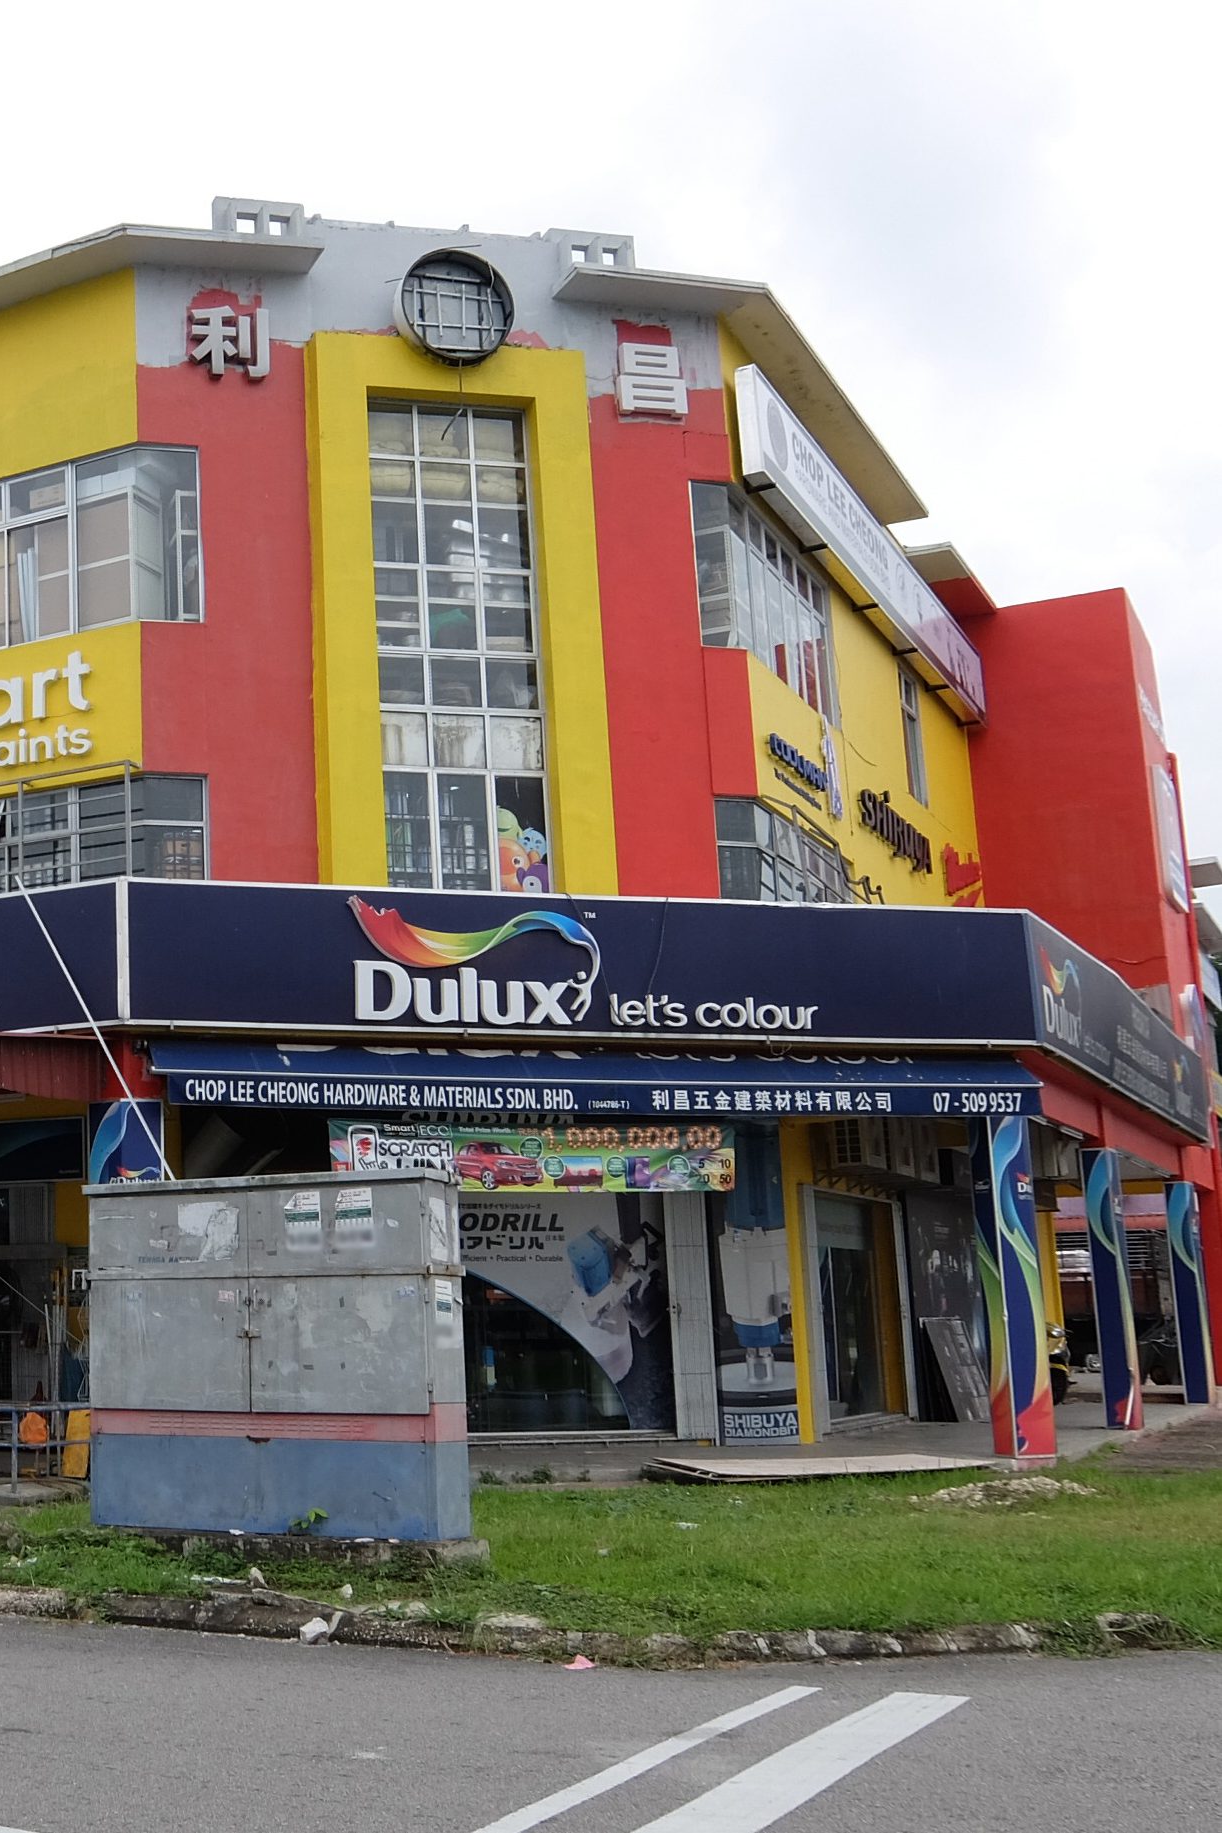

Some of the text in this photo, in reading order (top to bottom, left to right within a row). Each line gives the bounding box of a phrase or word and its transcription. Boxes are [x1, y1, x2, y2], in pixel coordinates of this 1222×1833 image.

[189, 305, 270, 380] 利
[616, 342, 688, 417] 昌
[791, 431, 889, 570] CHOP LEE CHEONG
[353, 959, 819, 1030] Dulux let's colour
[1041, 984, 1081, 1049] Dulux
[185, 1079, 227, 1101] CHOP
[229, 1080, 256, 1102] LEE
[257, 1081, 319, 1105] CHEONG
[323, 1083, 407, 1107] HARDWARE
[409, 1085, 420, 1106] &
[423, 1086, 504, 1109] MATERIALS
[506, 1087, 541, 1109] SDN.
[543, 1088, 579, 1110] BHD.
[652, 1089, 893, 1113] 利昌五金建築材料有限公司
[383, 1123, 449, 1136] Smart ECO
[378, 1141, 451, 1158] SCRATCH
[719, 1158, 731, 1169] 10
[719, 1174, 732, 1184] 50
[496, 1254, 527, 1262] Practical
[535, 1254, 563, 1262] Durable
[723, 1412, 798, 1428] SHIBUYA
